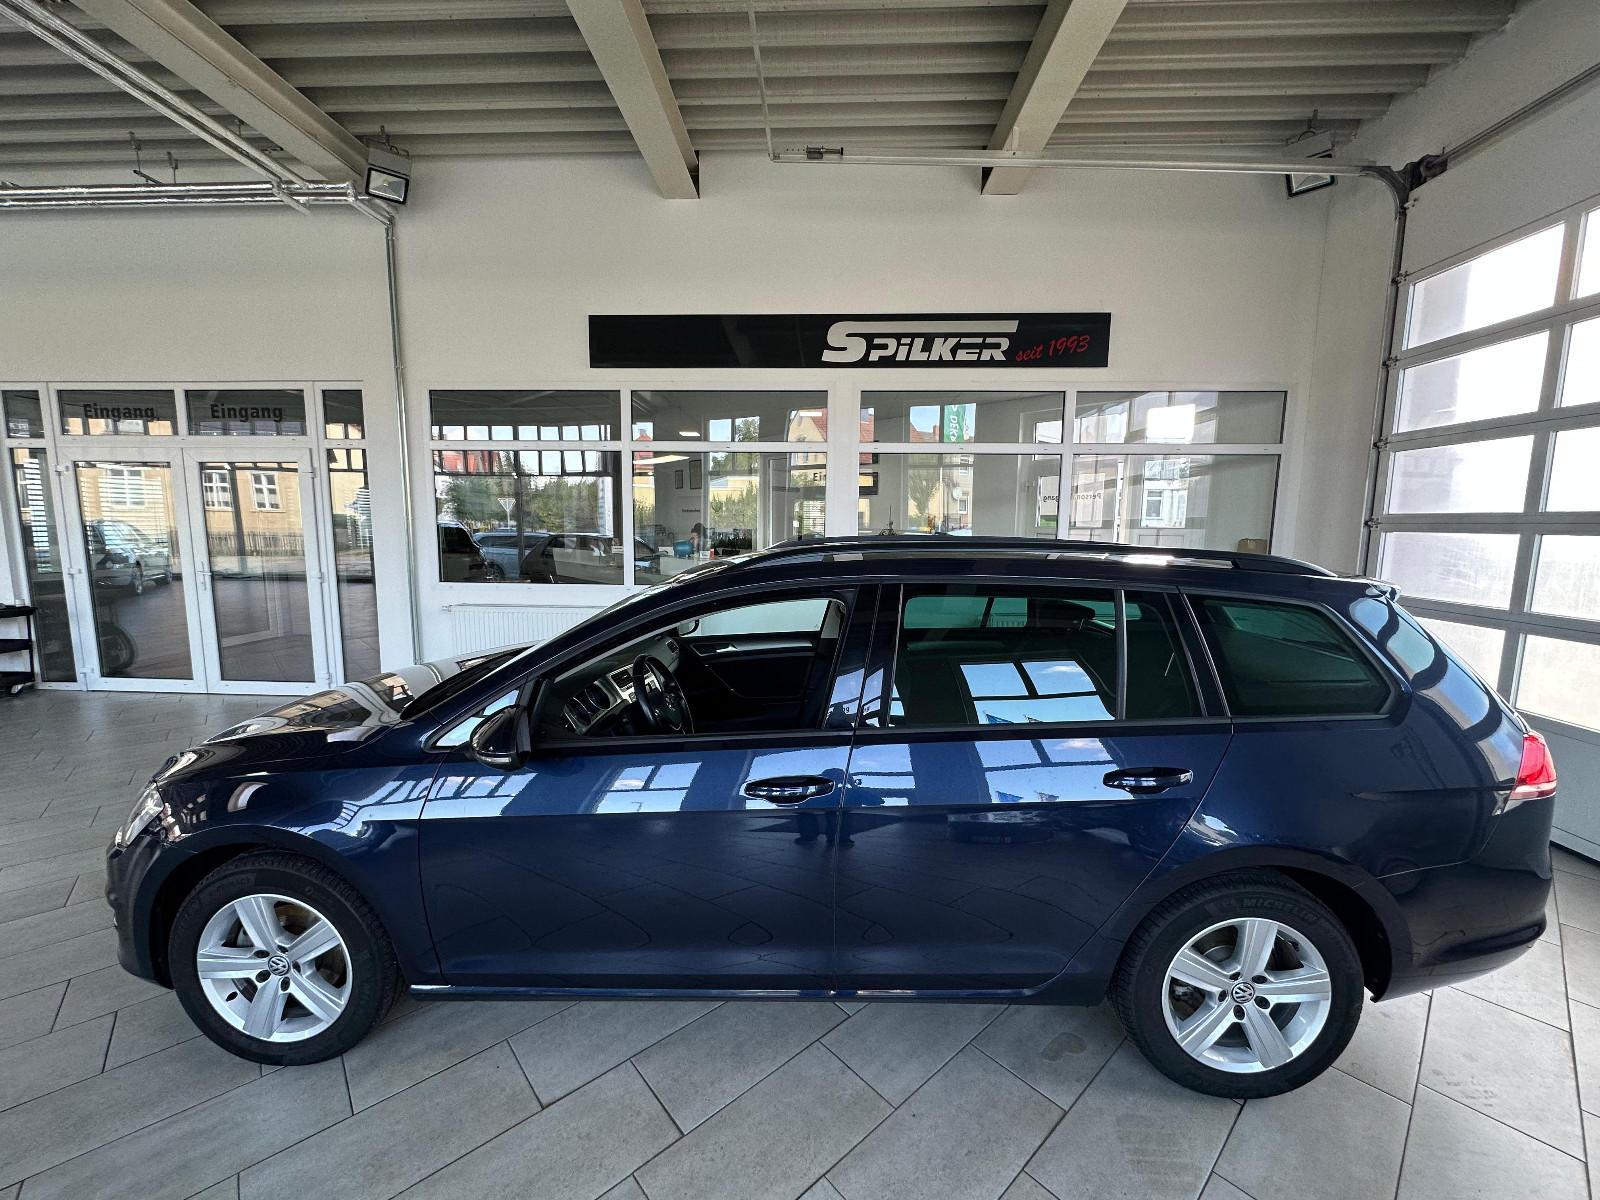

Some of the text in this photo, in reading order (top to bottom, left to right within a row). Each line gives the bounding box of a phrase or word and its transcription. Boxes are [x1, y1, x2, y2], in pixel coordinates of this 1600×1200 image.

[1015, 346, 1043, 362] seit
[1048, 334, 1091, 357] 1993
[83, 403, 155, 422] Eingang
[210, 403, 284, 422] Eingang
